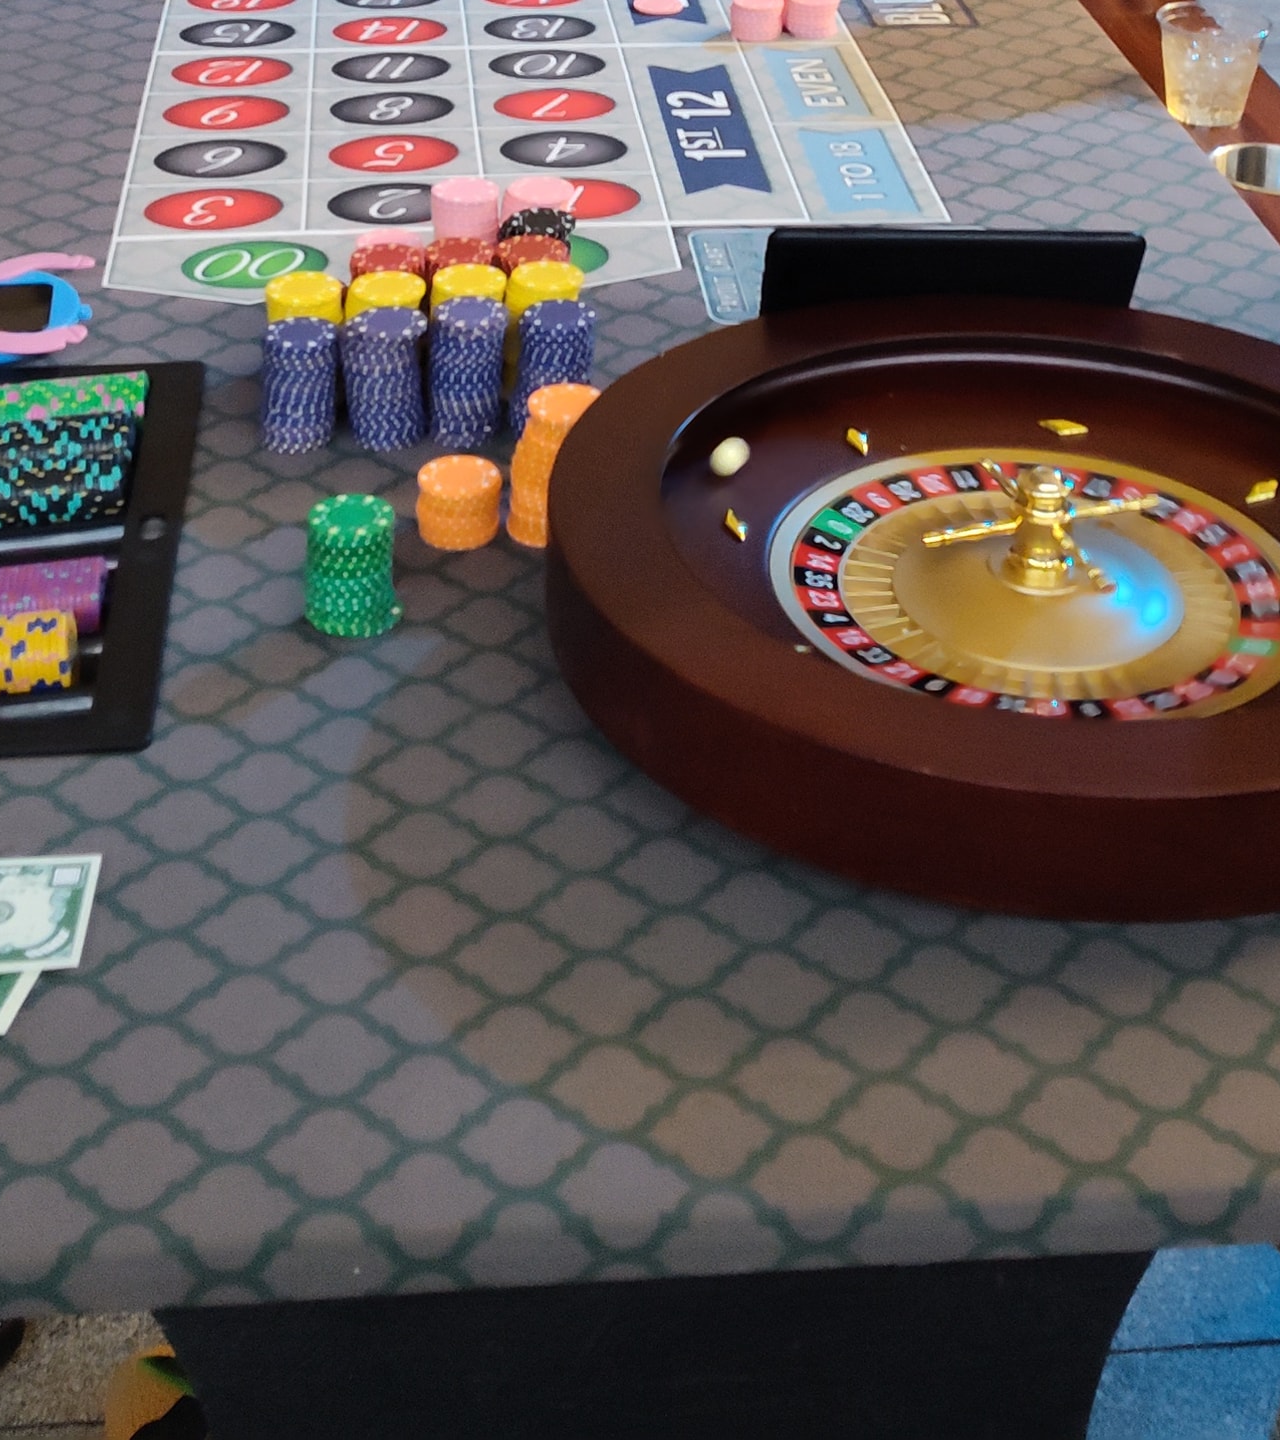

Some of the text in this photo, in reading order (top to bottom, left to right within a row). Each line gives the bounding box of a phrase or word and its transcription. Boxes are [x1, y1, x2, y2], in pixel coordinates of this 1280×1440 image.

[202, 22, 271, 45] 15
[362, 20, 419, 42] 14
[515, 17, 565, 39] 13
[199, 60, 262, 83] 12
[365, 57, 413, 79] 11
[514, 53, 576, 76] 10
[786, 57, 848, 109] EVEN
[200, 101, 238, 125] 9
[370, 97, 414, 121] 8
[532, 93, 571, 117] 7
[666, 90, 732, 120] 12
[363, 141, 414, 168] 5
[544, 137, 586, 162] 4
[676, 126, 747, 161] 1ST
[198, 146, 243, 174] 6
[829, 140, 887, 202] 1 TO 18
[182, 196, 234, 226] 3
[368, 189, 422, 219] 2
[192, 248, 307, 282] 00
[813, 535, 842, 551] 2
[805, 570, 834, 589] 35
